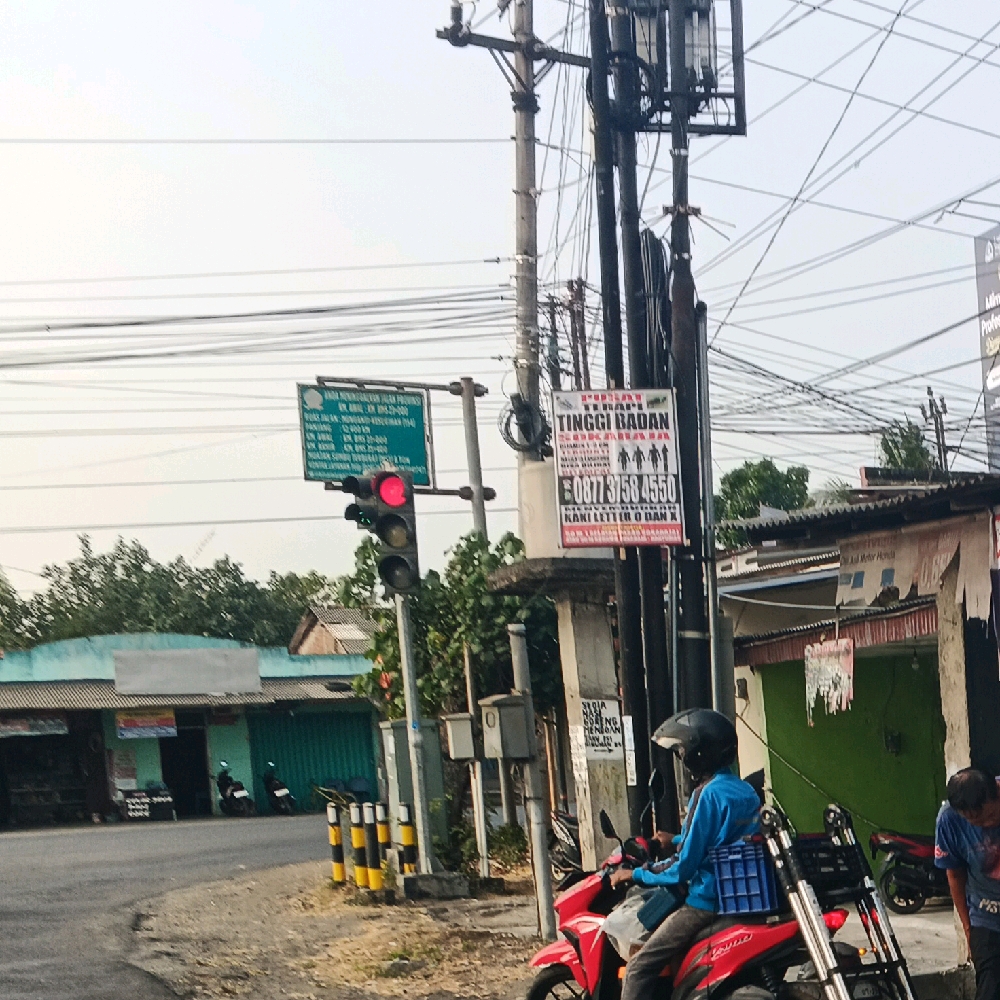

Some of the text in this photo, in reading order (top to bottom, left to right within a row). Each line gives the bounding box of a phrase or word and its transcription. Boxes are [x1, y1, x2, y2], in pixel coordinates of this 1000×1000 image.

[556, 412, 670, 431] TINGGI BADAN
[573, 474, 677, 504] 0877 3758 4550
[564, 512, 591, 522] KAKI
[593, 512, 632, 522] LETTER
[634, 512, 642, 522] O
[645, 512, 667, 522] DAN
